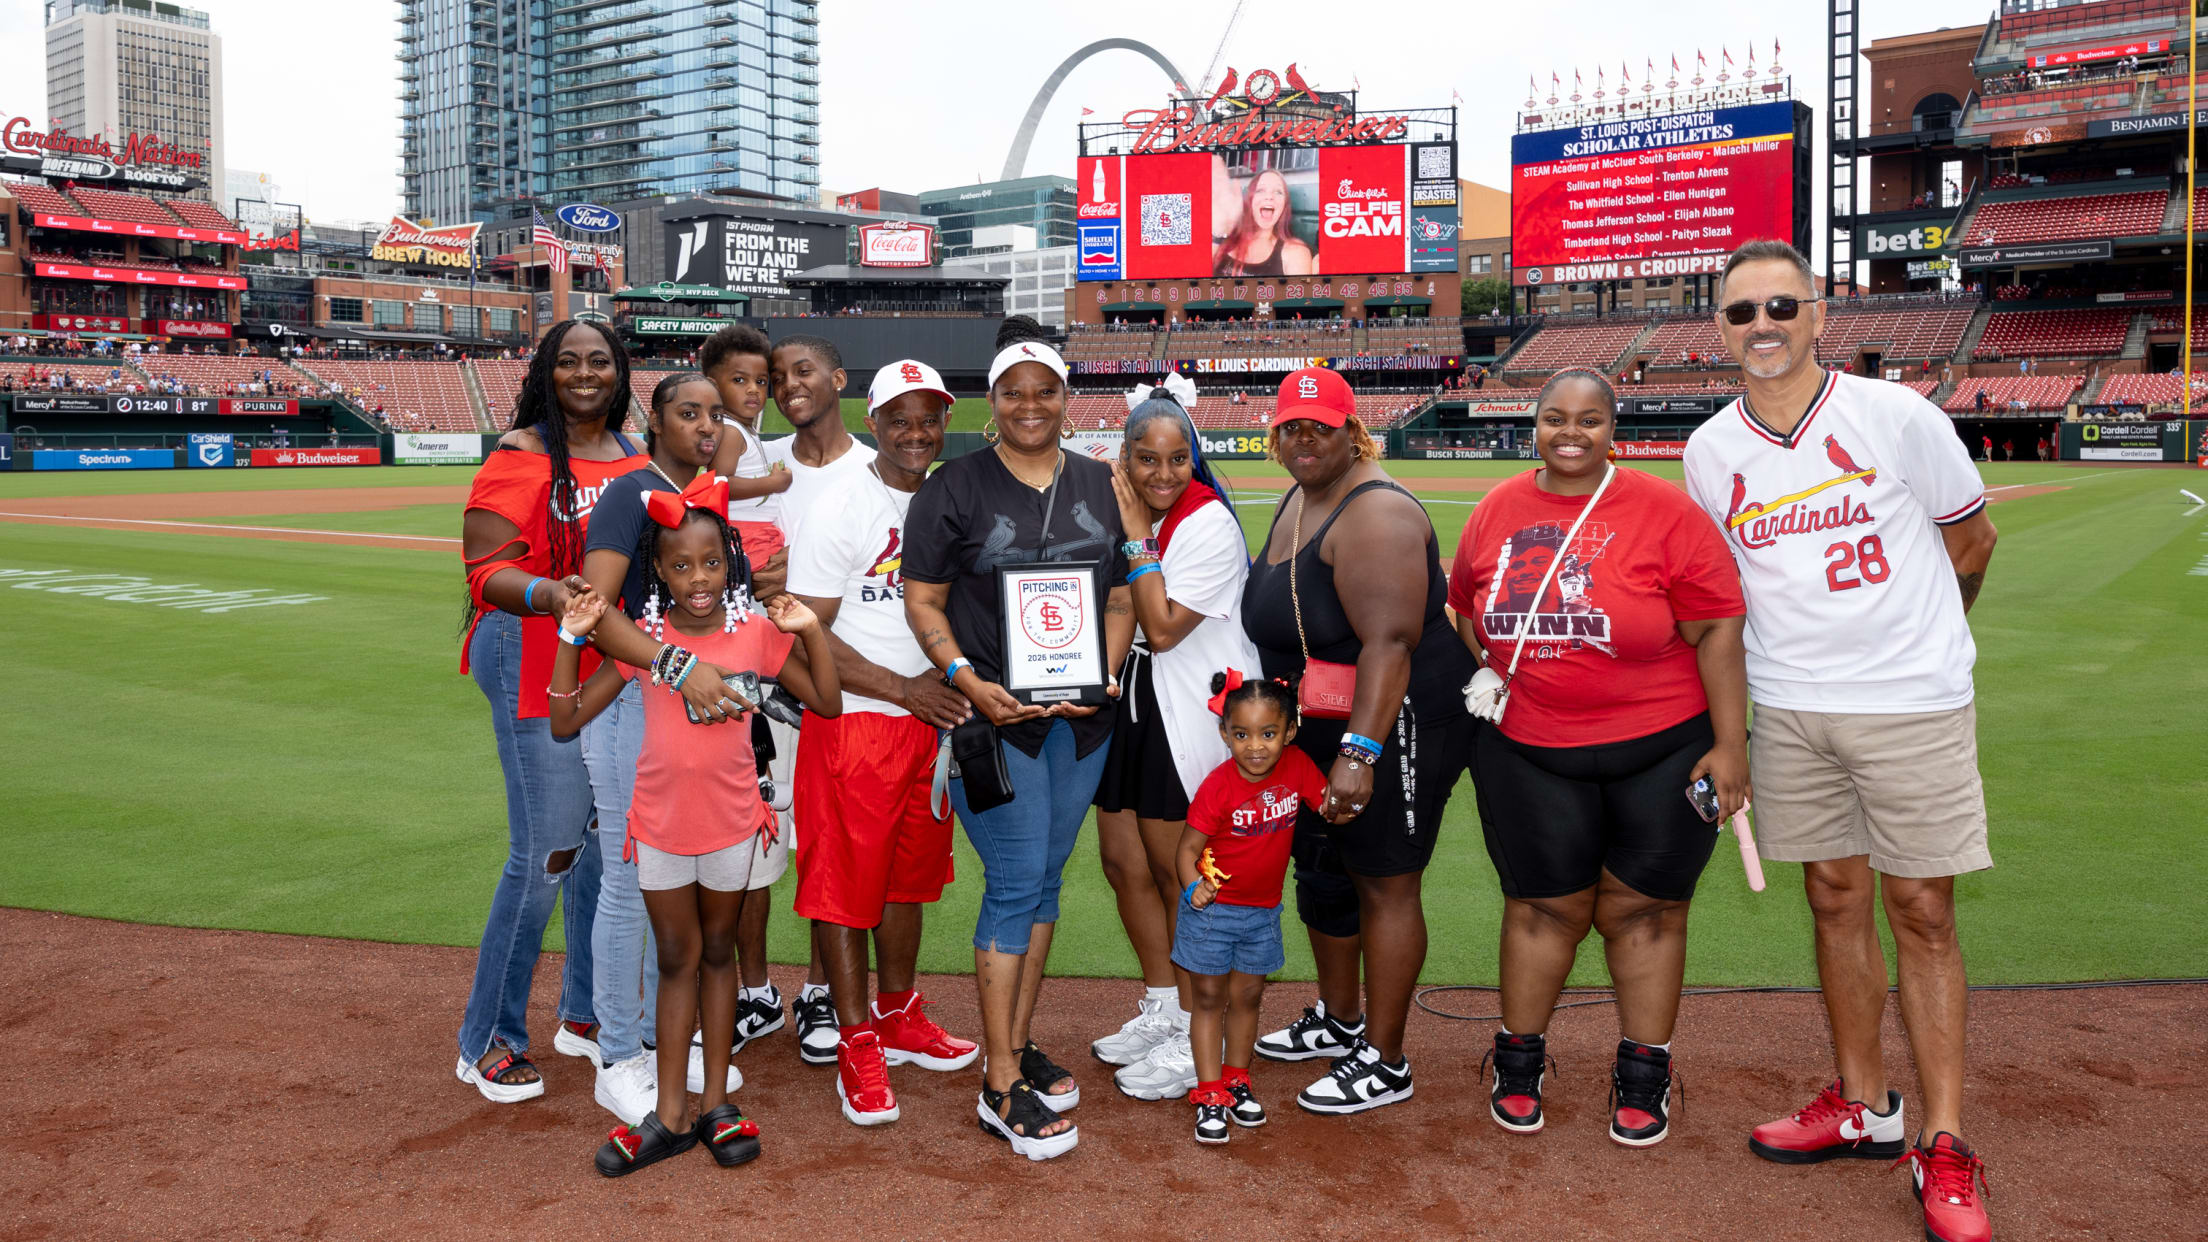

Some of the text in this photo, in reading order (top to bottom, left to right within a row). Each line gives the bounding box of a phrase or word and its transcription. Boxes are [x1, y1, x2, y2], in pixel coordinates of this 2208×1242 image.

[2077, 49, 2115, 60] Budweiser
[1540, 104, 1621, 126] WORLD
[1623, 84, 1763, 116] CHAMPIONS
[1122, 106, 1408, 154] Budweiser
[1581, 112, 1714, 140] ST. LOUIS POST-DISPATCH
[2111, 117, 2178, 131] BENJAMIN
[3, 117, 201, 168] Cardinals Nation
[1563, 124, 1734, 157] SCHOLAR ATHLETES
[42, 158, 104, 176] HOFFMANN
[1524, 141, 1779, 178] STEAM Academy at McCluer South Berkeley Malachi Miller
[124, 170, 186, 186] ROOFTOP
[1566, 167, 1729, 192] Sullivan High School Trenton Ahrens
[1414, 189, 1456, 200] DISASTER
[1569, 188, 1726, 210] The Whitfield School Ellen Hunigan
[572, 207, 609, 227] Ford
[1080, 202, 1119, 216] Coca-Cola
[1324, 201, 1402, 217] SELFIE
[1562, 206, 1734, 230] Thomas Jefferson School Elijah Albano
[378, 224, 479, 248] Budweiser
[1324, 215, 1402, 239] CAM
[243, 228, 299, 252] Live!
[725, 232, 810, 254] FROM THE
[871, 235, 920, 252] Coca-Cola
[1564, 235, 1610, 249] Timberland
[1612, 234, 1632, 246] High
[1634, 231, 1663, 243] School
[1703, 225, 1732, 238] Slezak
[373, 245, 481, 269] BREW HOUSE
[725, 249, 798, 269] LOU AND
[1907, 261, 1950, 271] bet365
[1970, 253, 1994, 264] Mercy
[725, 265, 780, 284] WE'RE
[1530, 272, 1540, 280] BC
[1554, 254, 1732, 282] BROWN & CROUPPE
[1121, 288, 1127, 302] 1
[1135, 289, 1144, 302] 2
[1151, 288, 1161, 301] 6
[1169, 287, 1178, 301] 9
[1187, 287, 1201, 301] 10
[1210, 286, 1224, 300] 14
[1233, 286, 1248, 300] 17
[1256, 285, 1275, 299] 20
[1286, 285, 1304, 298] 23
[1312, 284, 1331, 298] 24
[1340, 283, 1359, 297] 42
[1368, 282, 1388, 297] 45
[1394, 282, 1413, 296] 85
[641, 320, 729, 332] SAFETY NATIONA
[1077, 356, 1441, 374] BUSCH STADIUM ST. LOUIS CARDINALS BUSCH STADIUM
[25, 400, 50, 411] Mercy
[136, 401, 168, 411] 12:40
[244, 401, 284, 412] PURINA
[1474, 402, 1533, 413] Schnucks
[2101, 426, 2157, 435] Cordell Cordell
[2166, 422, 2181, 432] 335'
[191, 433, 230, 444] CarShield
[417, 442, 449, 451] Ameren
[79, 454, 128, 465] Spectrum
[236, 458, 250, 467] 375'
[296, 452, 359, 464] Budweiser
[1426, 450, 1493, 459] BUSCH STADIUM
[2121, 450, 2157, 458] Cordell.com
[1738, 494, 1875, 550] Cardinals
[1823, 534, 1892, 593] 28
[1022, 582, 1068, 593] PITCHING
[1484, 613, 1608, 641] WINN
[1049, 652, 1082, 661] HONOREE
[1320, 693, 1350, 707] STEVE
[1400, 755, 1410, 791] 2025 GRAD
[1232, 792, 1298, 826] ST. LOUIS
[1406, 810, 1415, 828] GRAD
